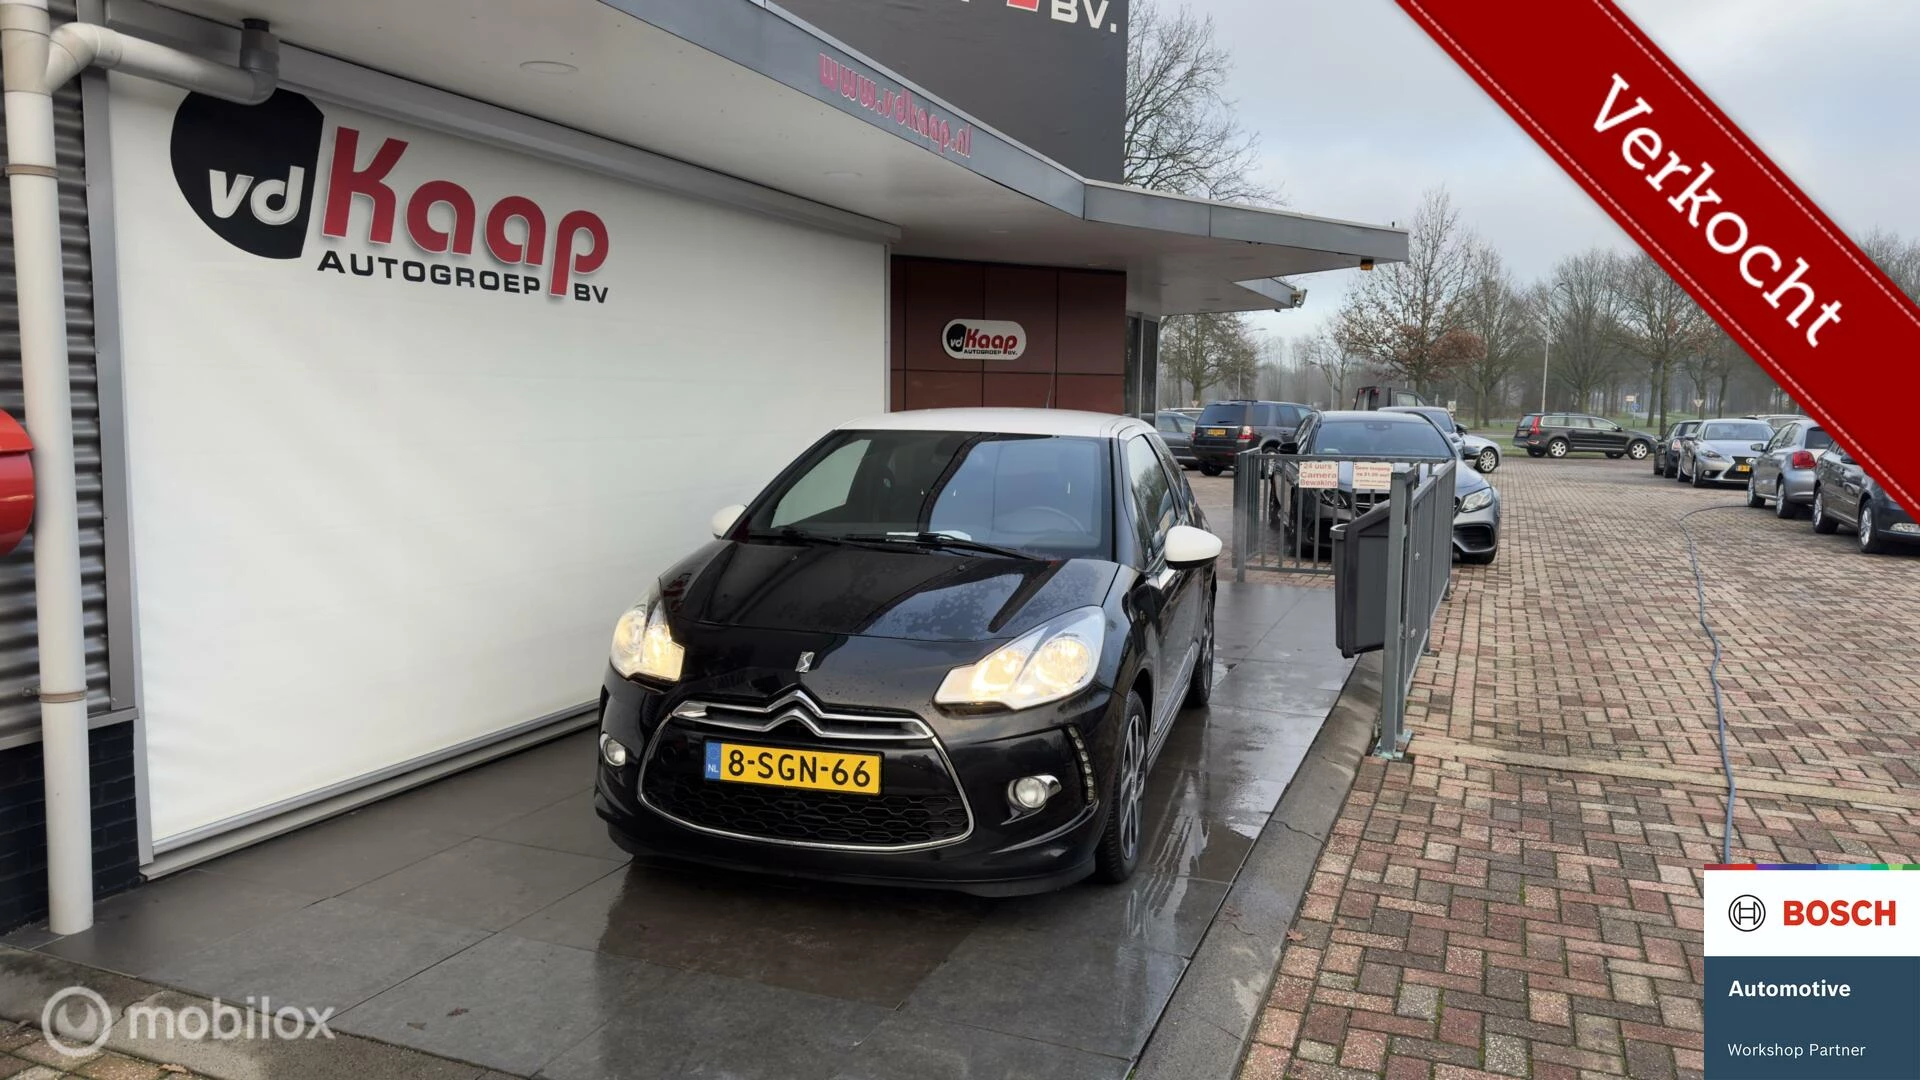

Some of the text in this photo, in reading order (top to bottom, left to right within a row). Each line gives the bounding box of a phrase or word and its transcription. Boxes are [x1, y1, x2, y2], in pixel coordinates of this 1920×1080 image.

[819, 52, 973, 159] www.vdkaap.nl
[208, 125, 610, 297] vd Kaap
[317, 249, 609, 304] AUTOGROEP BV
[950, 328, 1018, 354] vd Kaap
[1300, 479, 1337, 487] Bewaking
[707, 749, 871, 788] NL 8-SGN-66
